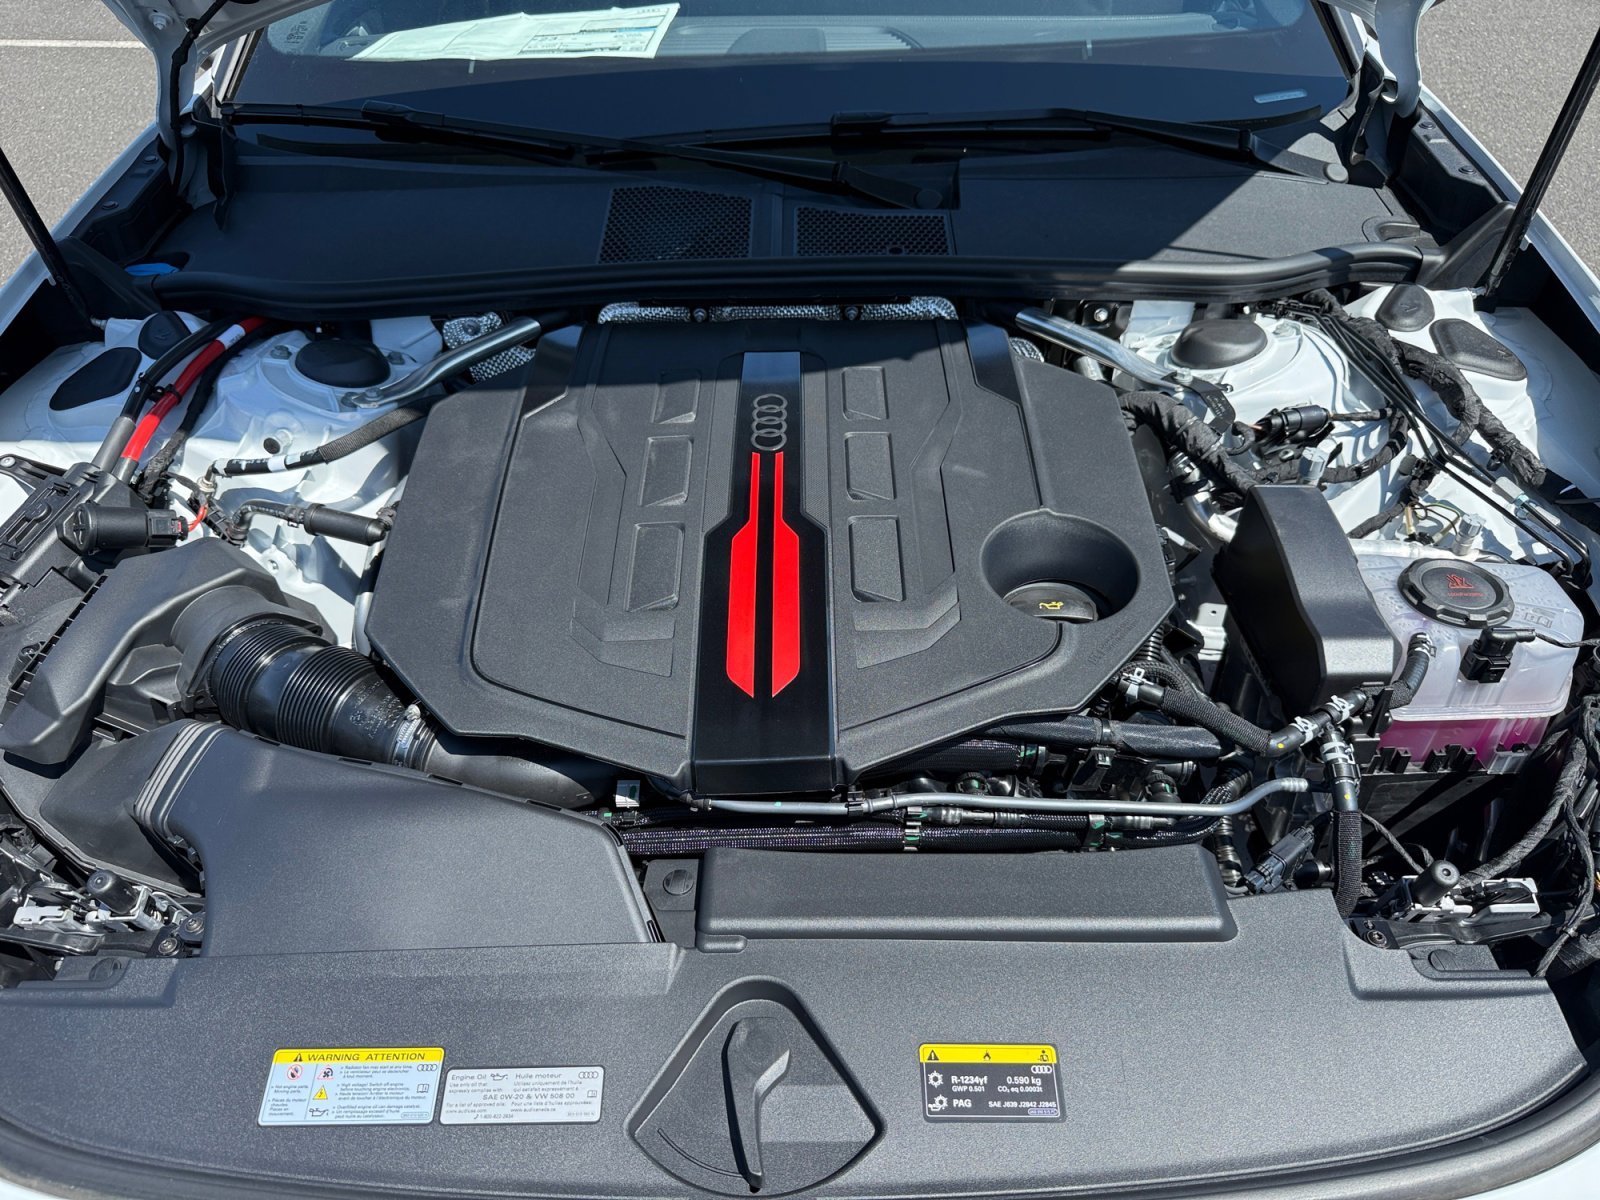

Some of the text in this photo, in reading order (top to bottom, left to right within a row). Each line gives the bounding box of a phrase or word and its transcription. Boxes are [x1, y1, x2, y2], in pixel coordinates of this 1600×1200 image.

[951, 1075, 1042, 1086] R-1234yf 0.590 kg
[953, 1099, 972, 1108] PAG
